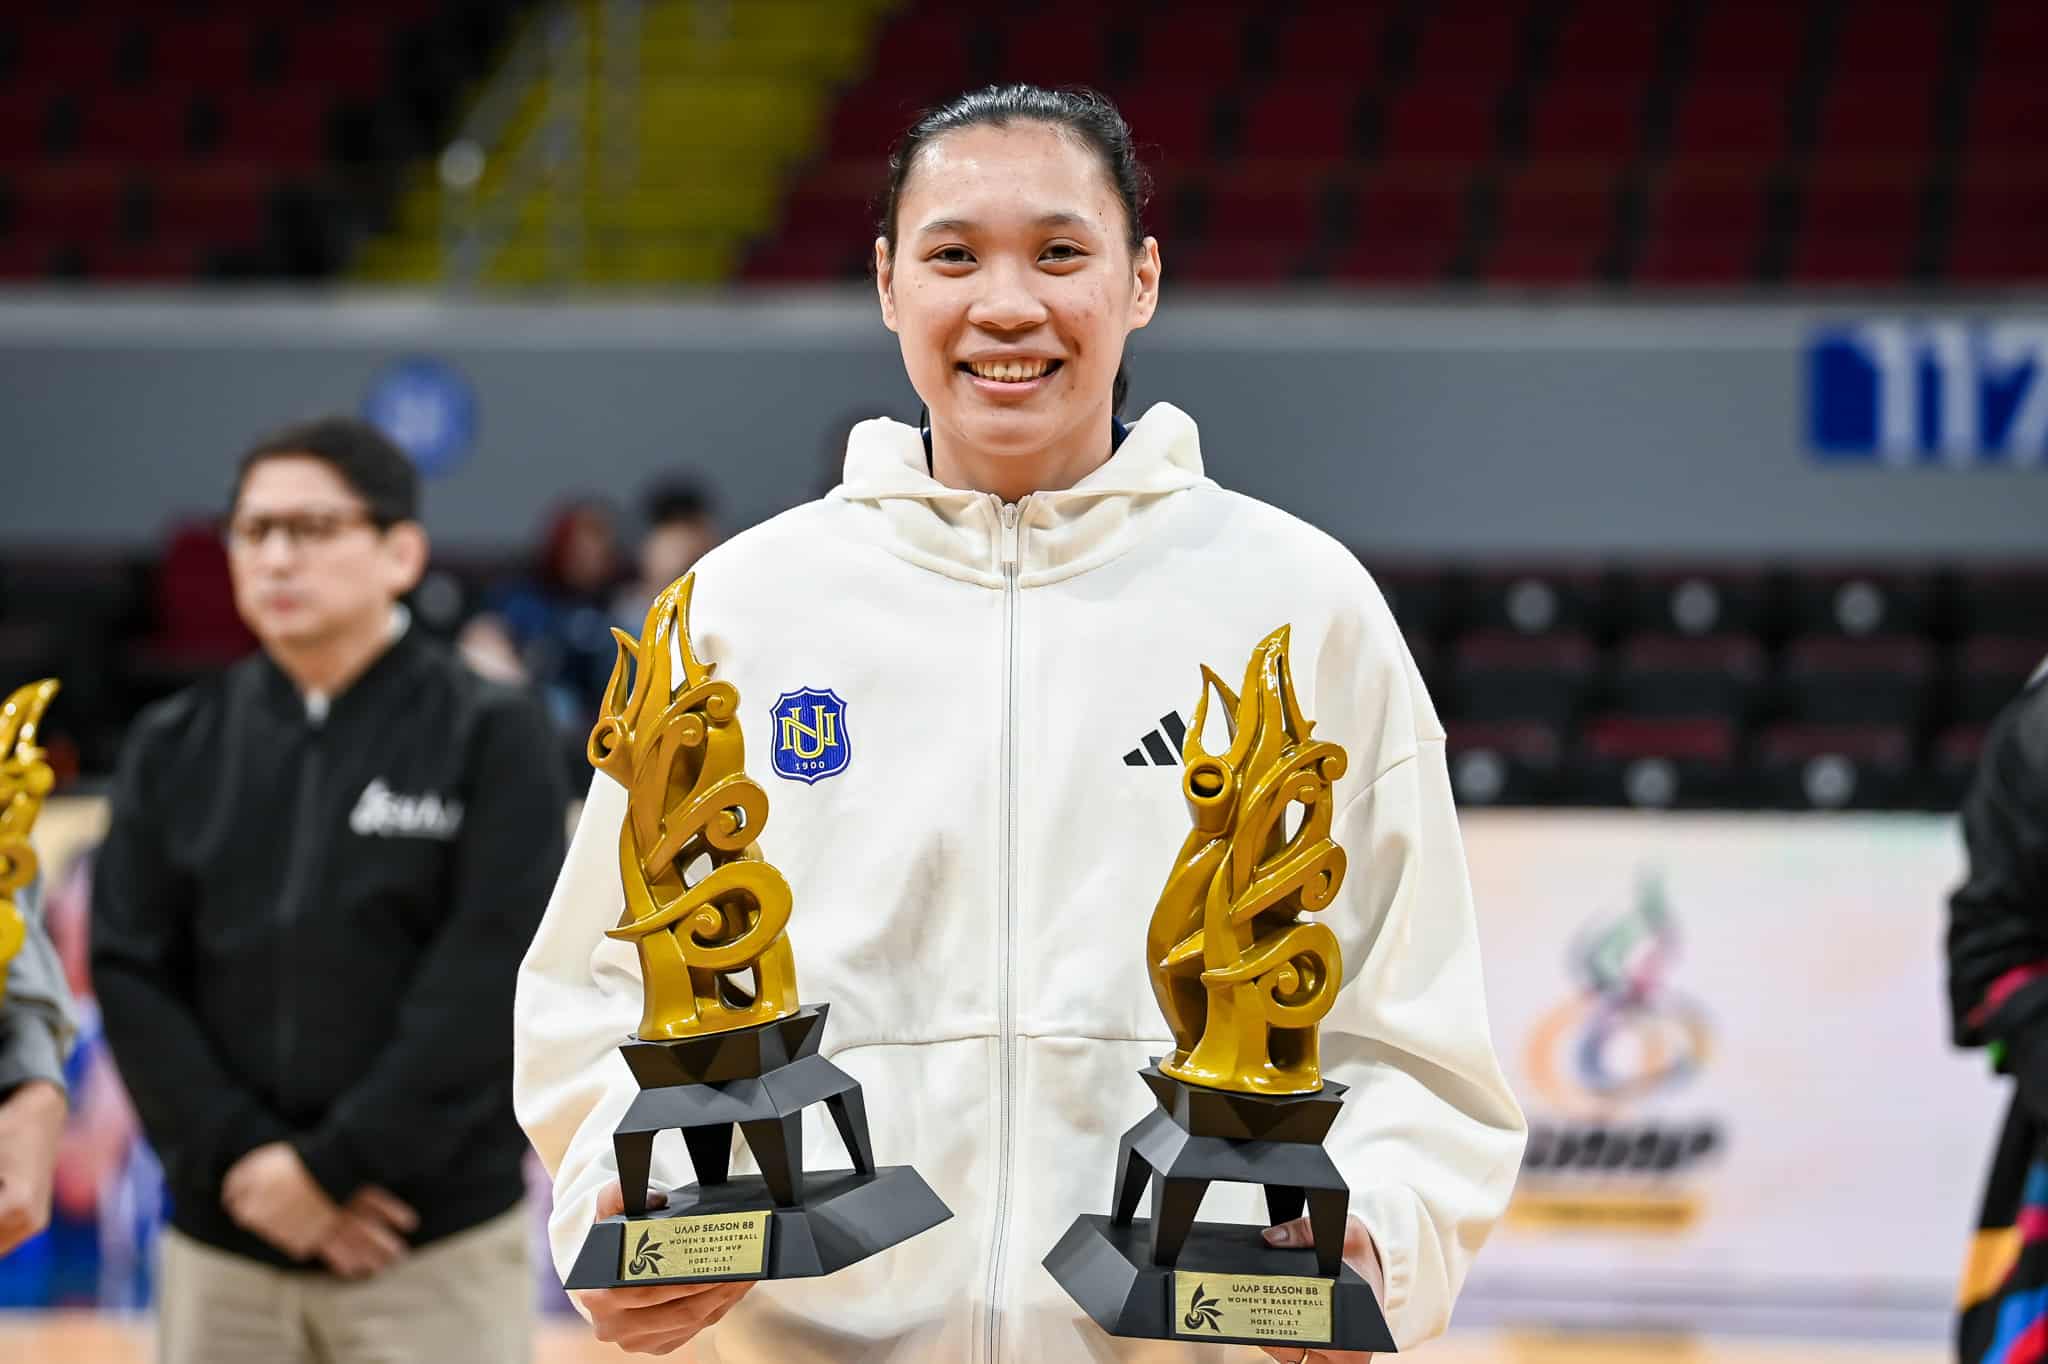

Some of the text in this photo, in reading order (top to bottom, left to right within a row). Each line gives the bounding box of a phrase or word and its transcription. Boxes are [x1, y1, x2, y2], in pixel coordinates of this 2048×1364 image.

[795, 760, 825, 770] 1900
[674, 1225, 700, 1234] UAAP
[702, 1221, 740, 1232] SEASON
[669, 1233, 759, 1245] WOMEN'S BASKETBALL
[684, 1245, 722, 1254] SEASON'S
[1232, 1283, 1260, 1293] UAAP
[1262, 1285, 1303, 1295] SEASON
[1227, 1296, 1324, 1306] WOMEN'S BASKETBALL
[1250, 1307, 1294, 1316] MYTHICAL
